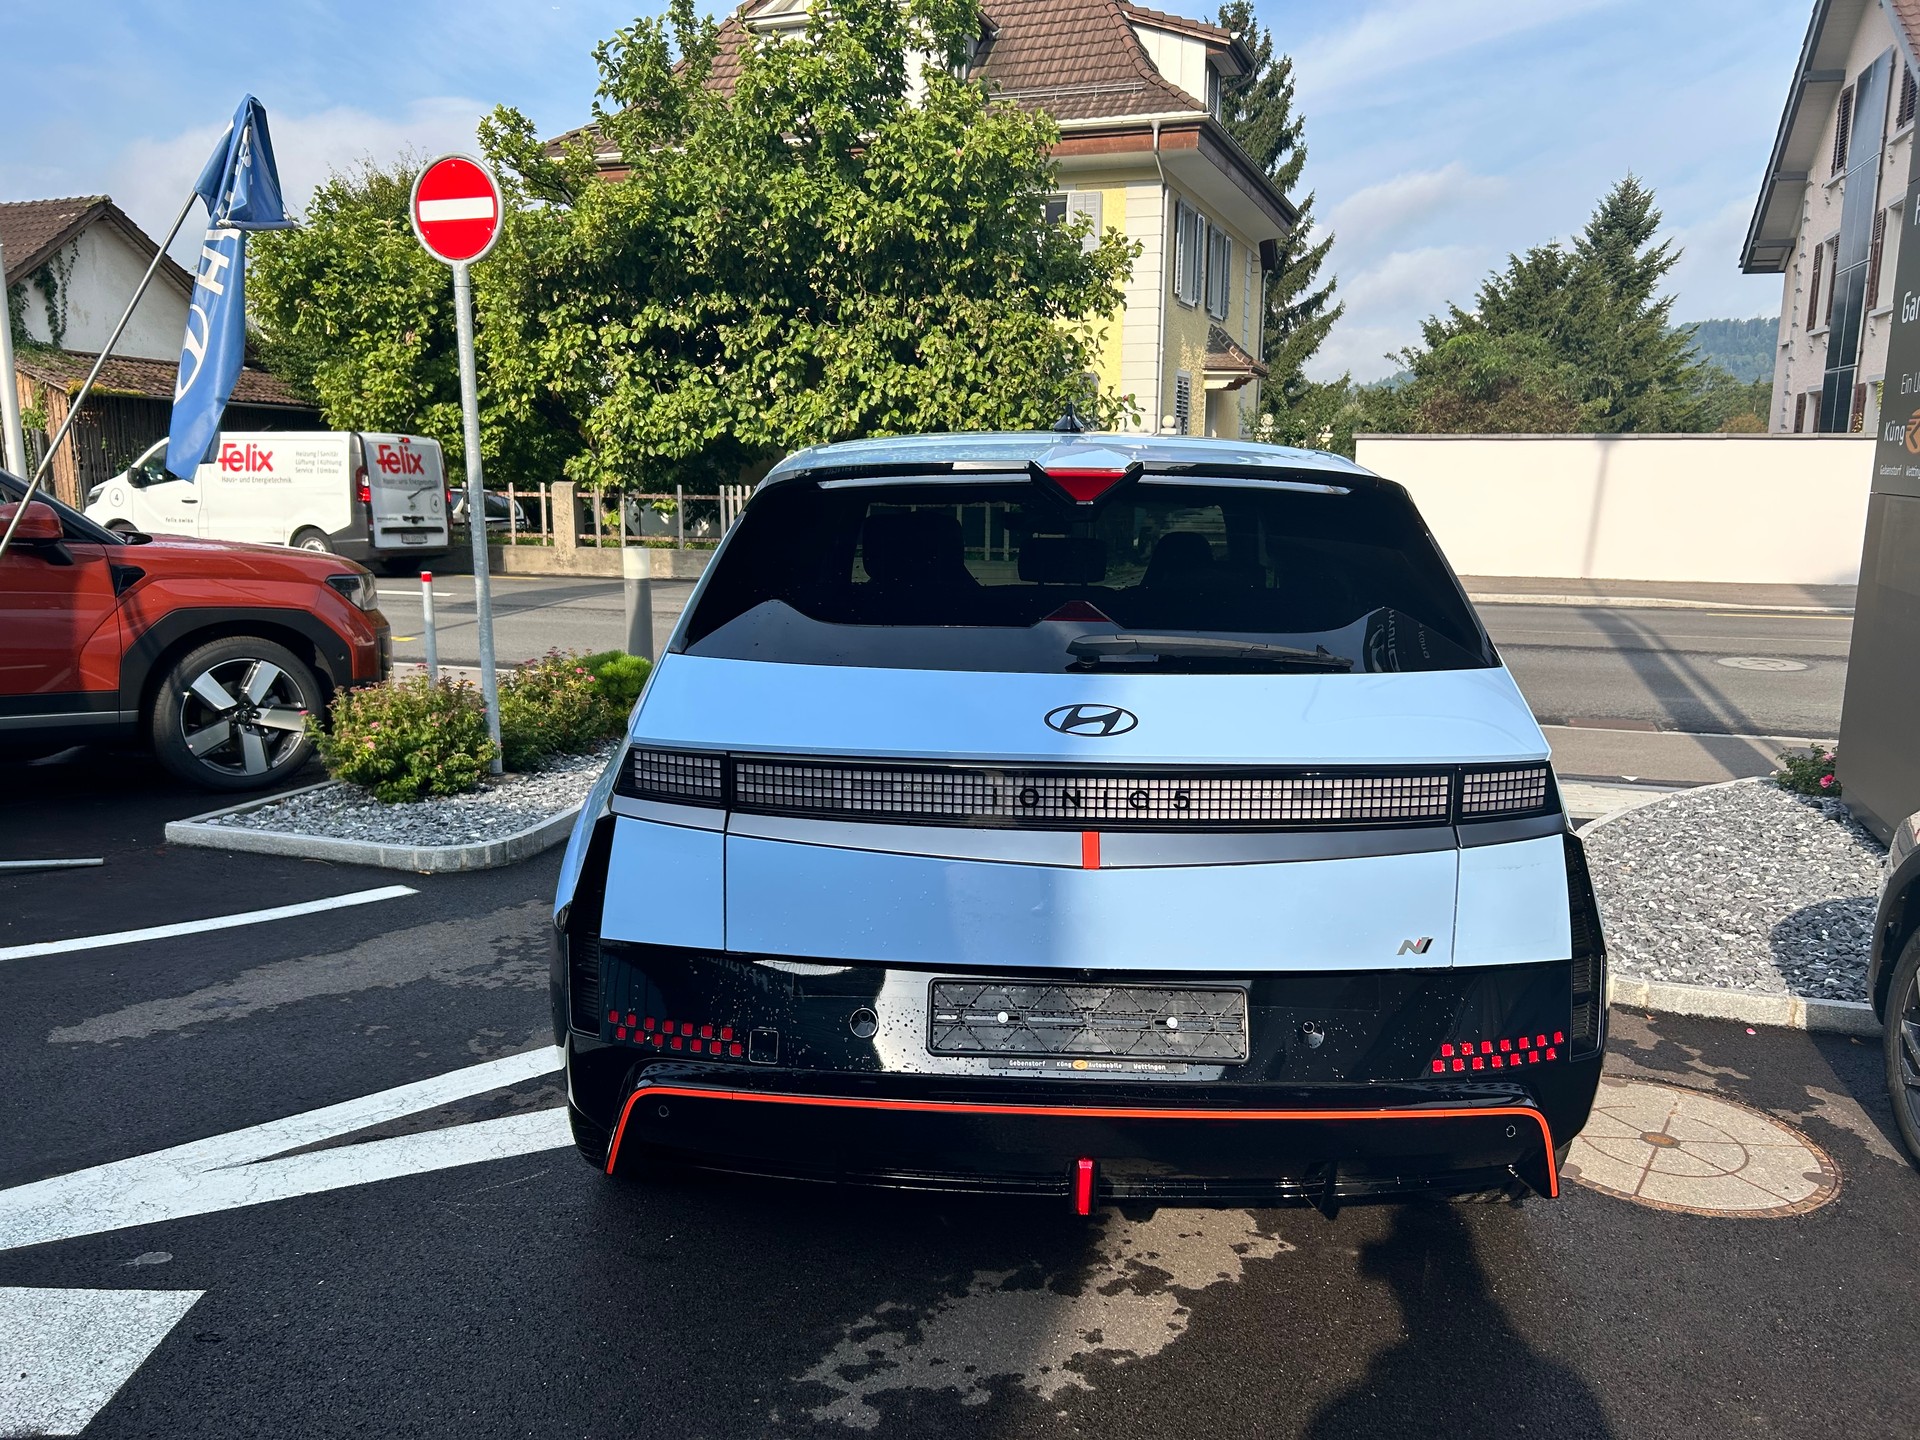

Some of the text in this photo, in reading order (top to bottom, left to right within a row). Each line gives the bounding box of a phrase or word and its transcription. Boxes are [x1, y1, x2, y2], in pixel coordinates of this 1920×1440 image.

[1884, 420, 1906, 446] Küng
[218, 443, 274, 472] Felix
[376, 444, 425, 476] Felix
[239, 476, 251, 484] und
[1008, 1059, 1167, 1072] Gebenstorf Küng Automobile Wettingen
